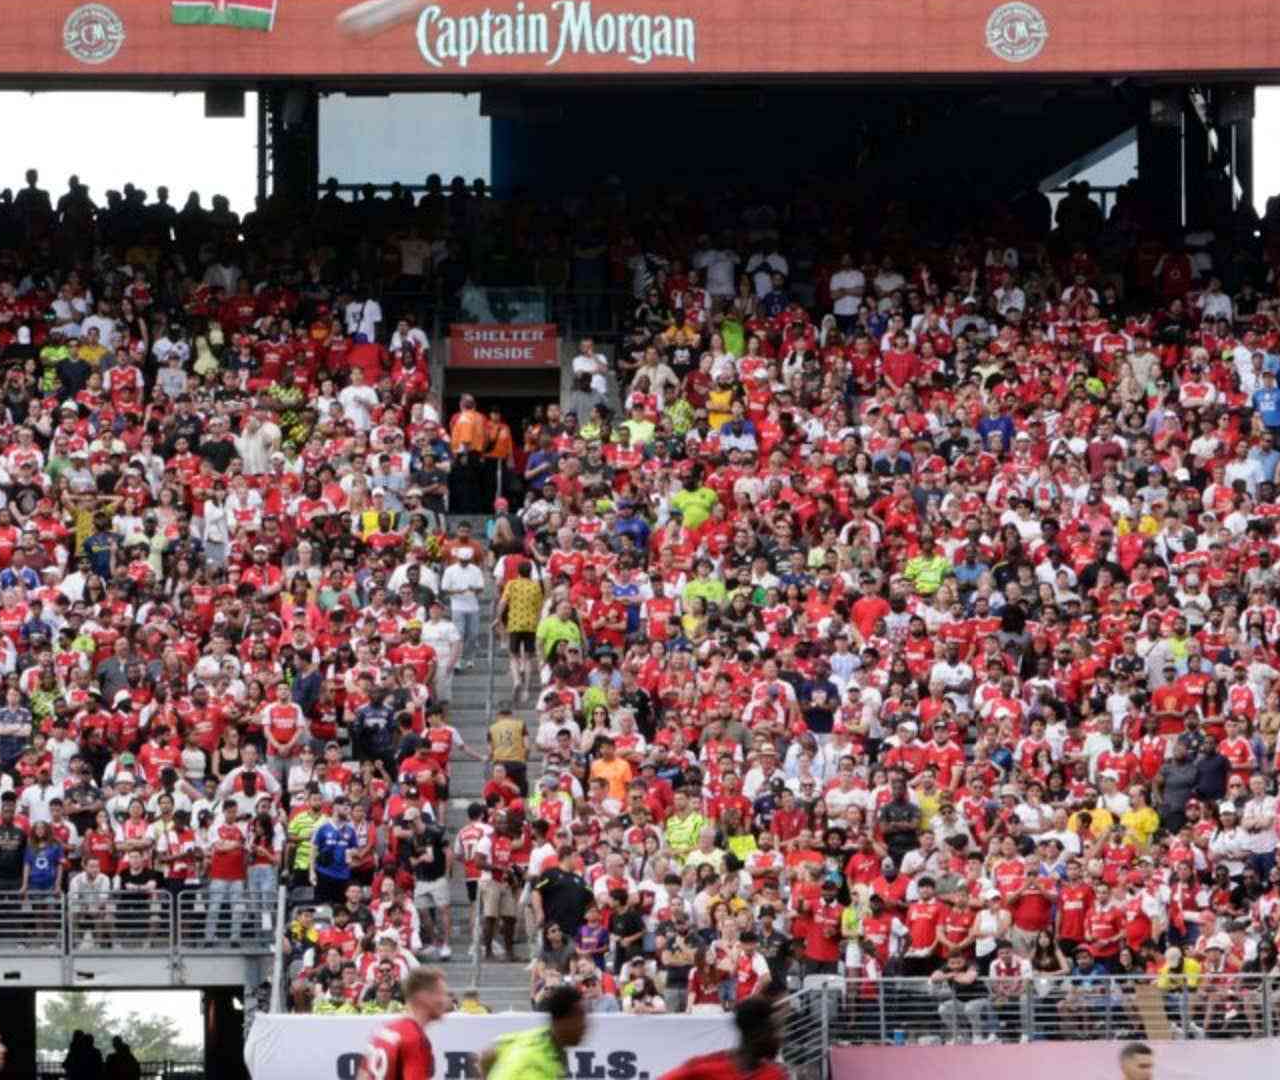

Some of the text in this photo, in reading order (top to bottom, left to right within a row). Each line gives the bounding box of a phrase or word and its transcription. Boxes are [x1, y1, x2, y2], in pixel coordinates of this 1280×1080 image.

[415, 0, 697, 68] Captain Morgan
[463, 329, 545, 343] SHELTER
[472, 347, 536, 360] INSIDE
